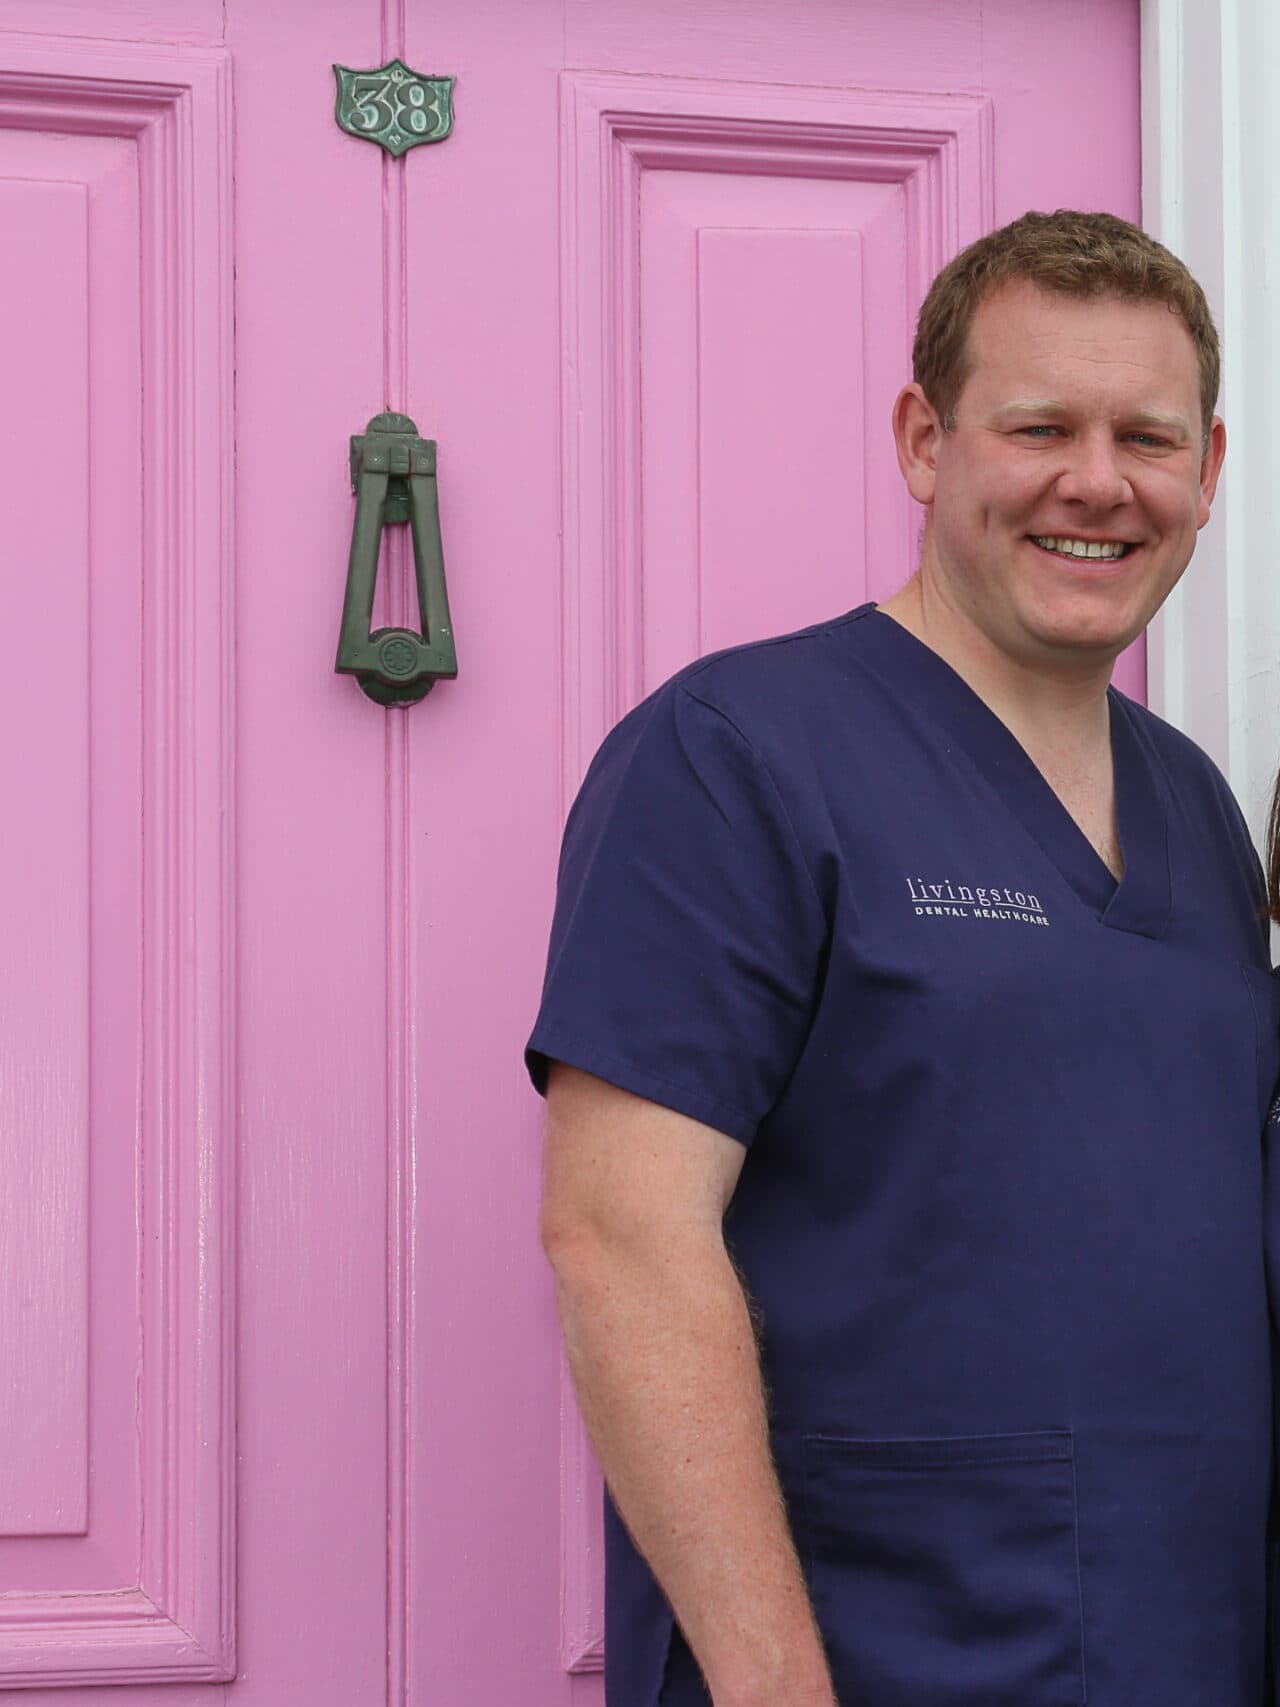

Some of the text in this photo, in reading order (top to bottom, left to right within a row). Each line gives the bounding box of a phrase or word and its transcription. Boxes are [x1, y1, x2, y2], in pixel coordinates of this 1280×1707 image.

[350, 77, 442, 135] 38
[906, 878, 1042, 909] livingston
[914, 906, 1050, 926] DENTAL HEALTHCARE
